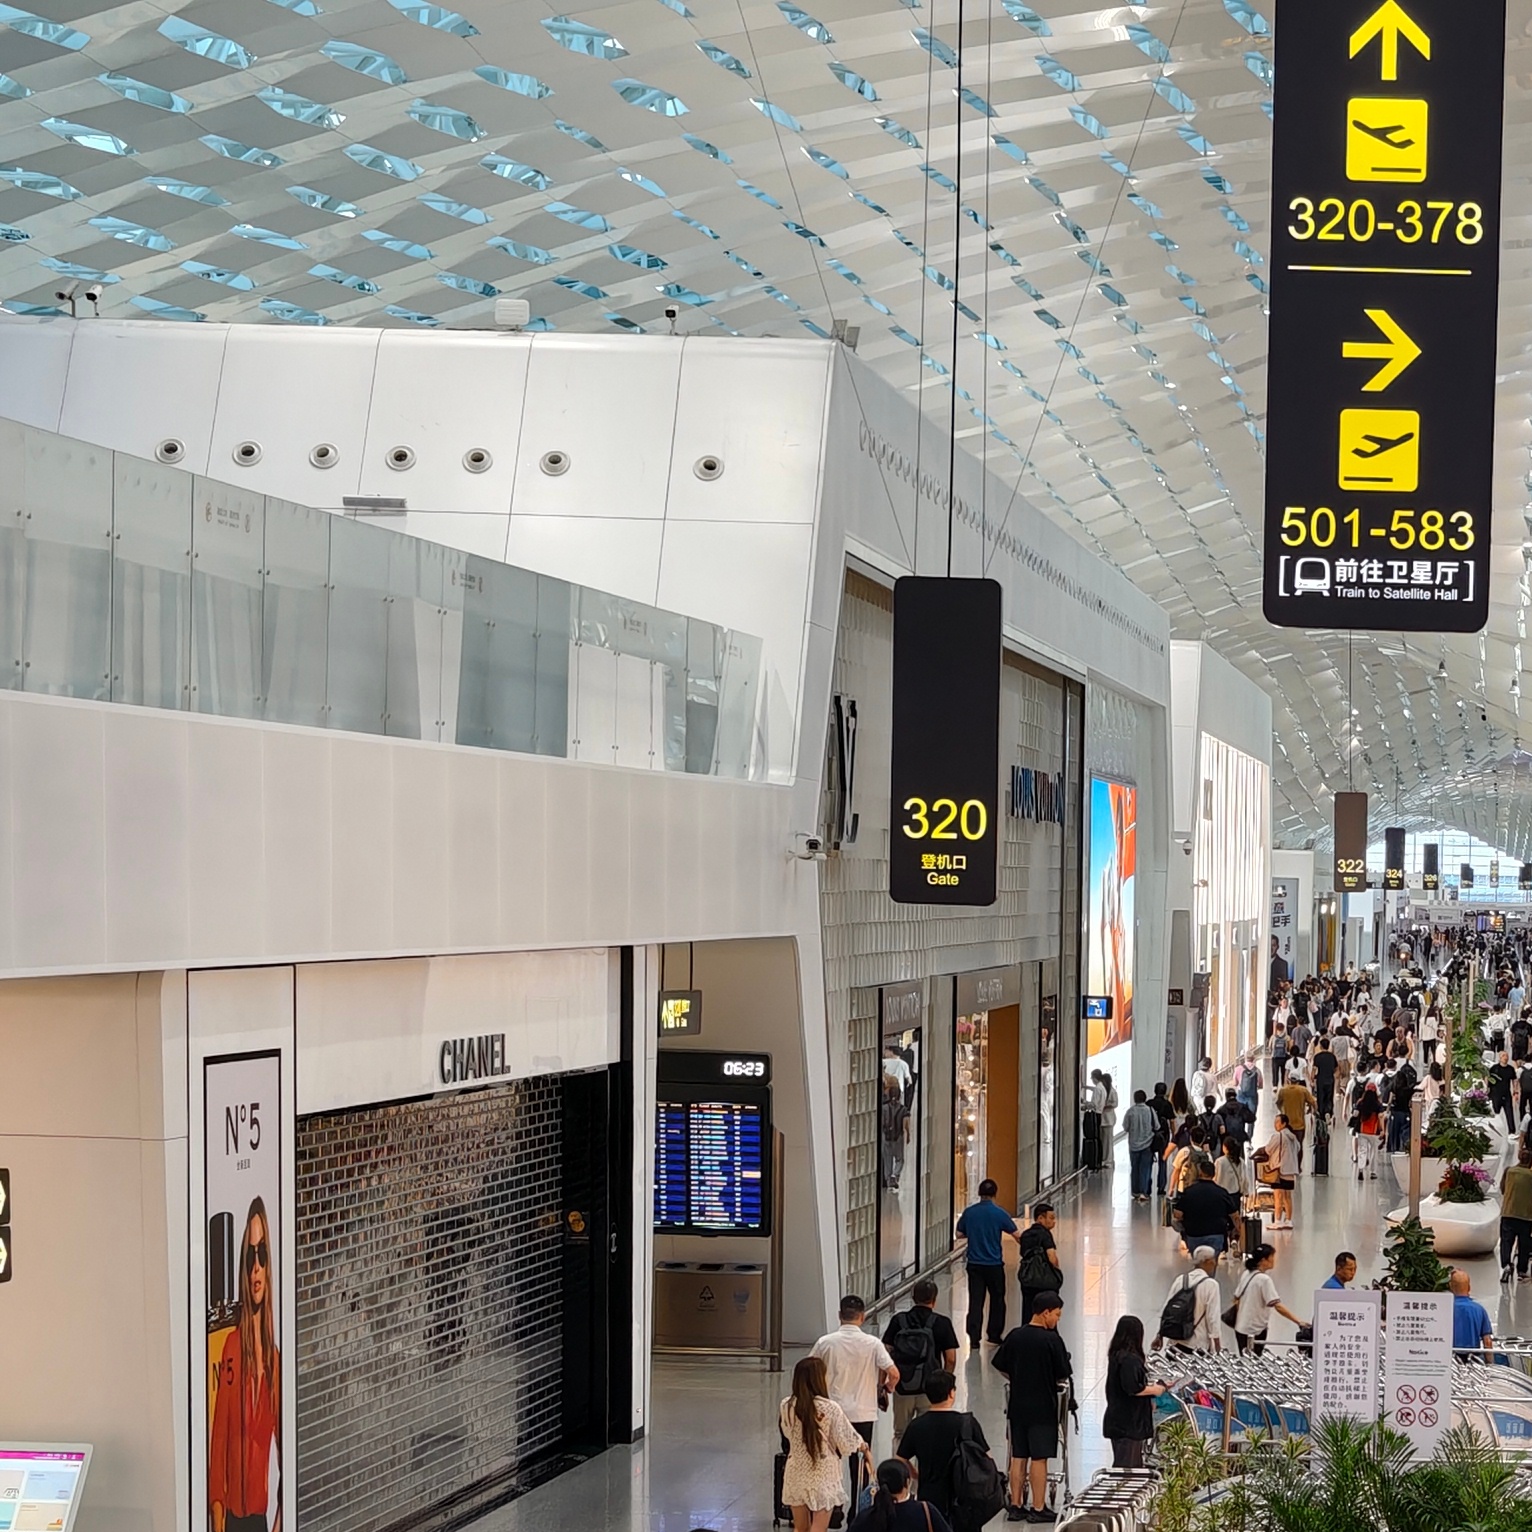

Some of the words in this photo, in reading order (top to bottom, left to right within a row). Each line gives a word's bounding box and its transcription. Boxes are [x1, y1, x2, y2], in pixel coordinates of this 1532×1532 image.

[1288, 197, 1484, 245] 320-378
[1280, 506, 1475, 551] 501-583
[1334, 558, 1460, 586] 前往卫星厅
[1334, 585, 1366, 599] Train
[1368, 587, 1381, 599] to
[1383, 587, 1432, 601] Satellite
[1434, 588, 1458, 601] Hall
[902, 797, 987, 841] 320
[921, 854, 967, 870] 登机口
[1337, 859, 1364, 873] 322
[926, 872, 959, 886] Gate
[1386, 869, 1403, 878] 324
[439, 1033, 511, 1084] CHANEL
[723, 1061, 765, 1077] 06:23
